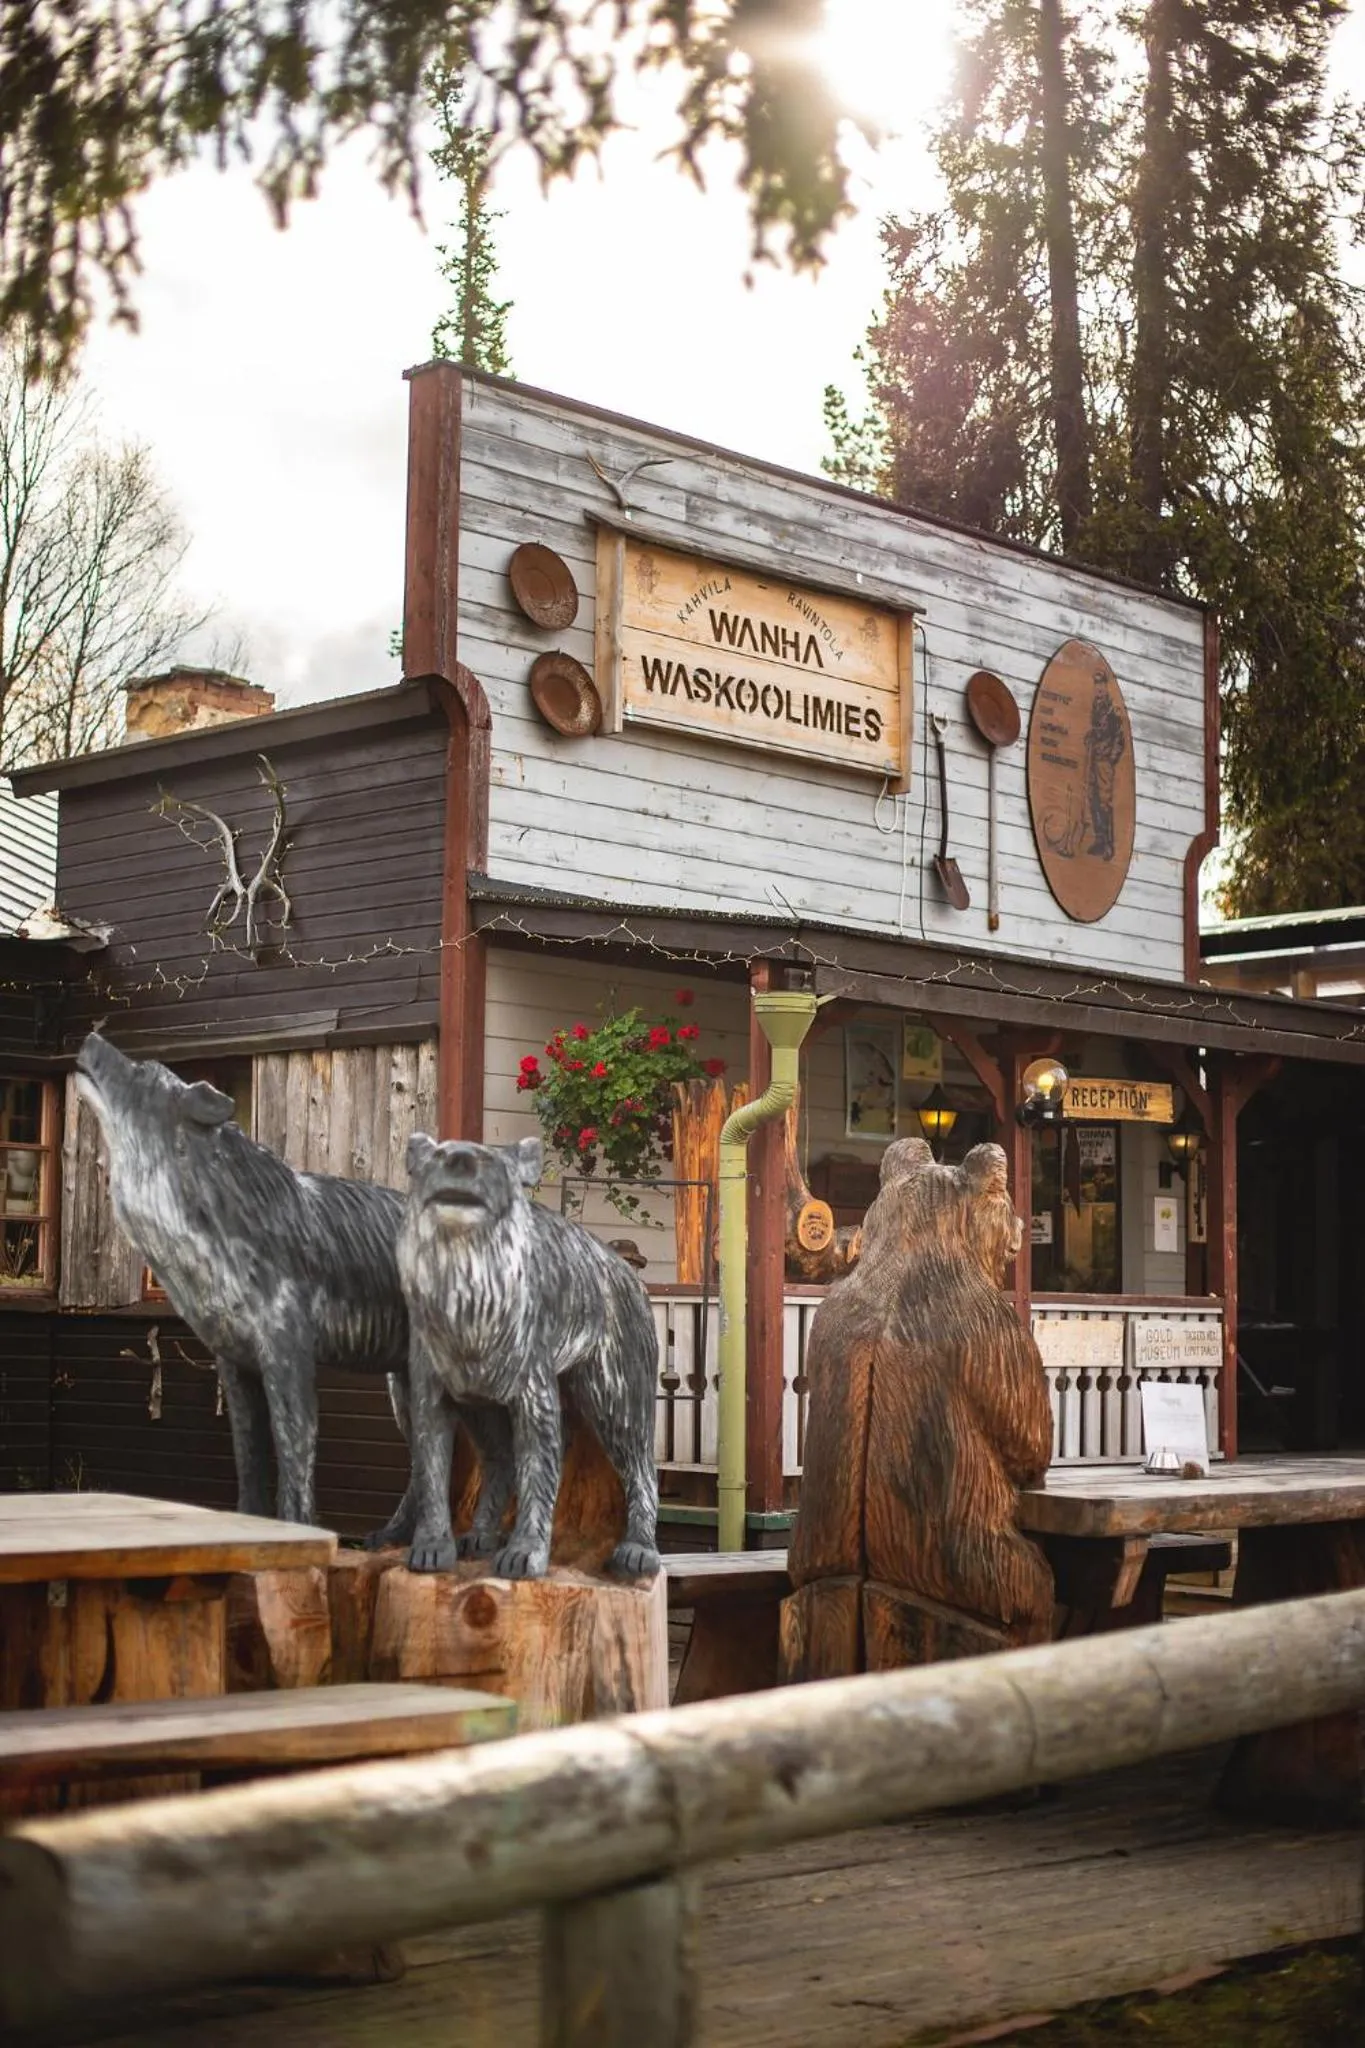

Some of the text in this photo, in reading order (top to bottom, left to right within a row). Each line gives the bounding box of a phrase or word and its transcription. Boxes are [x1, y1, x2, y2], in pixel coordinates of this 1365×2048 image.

[676, 577, 732, 624] KAHVILA
[786, 591, 843, 661] RAVINTOLA
[708, 608, 824, 668] WANHA
[641, 655, 883, 742] WASKOOLIMIES
[1071, 1086, 1148, 1110] RECEPTION
[1140, 1344, 1180, 1361] MUSEUM
[1146, 1328, 1173, 1343] GOLD
